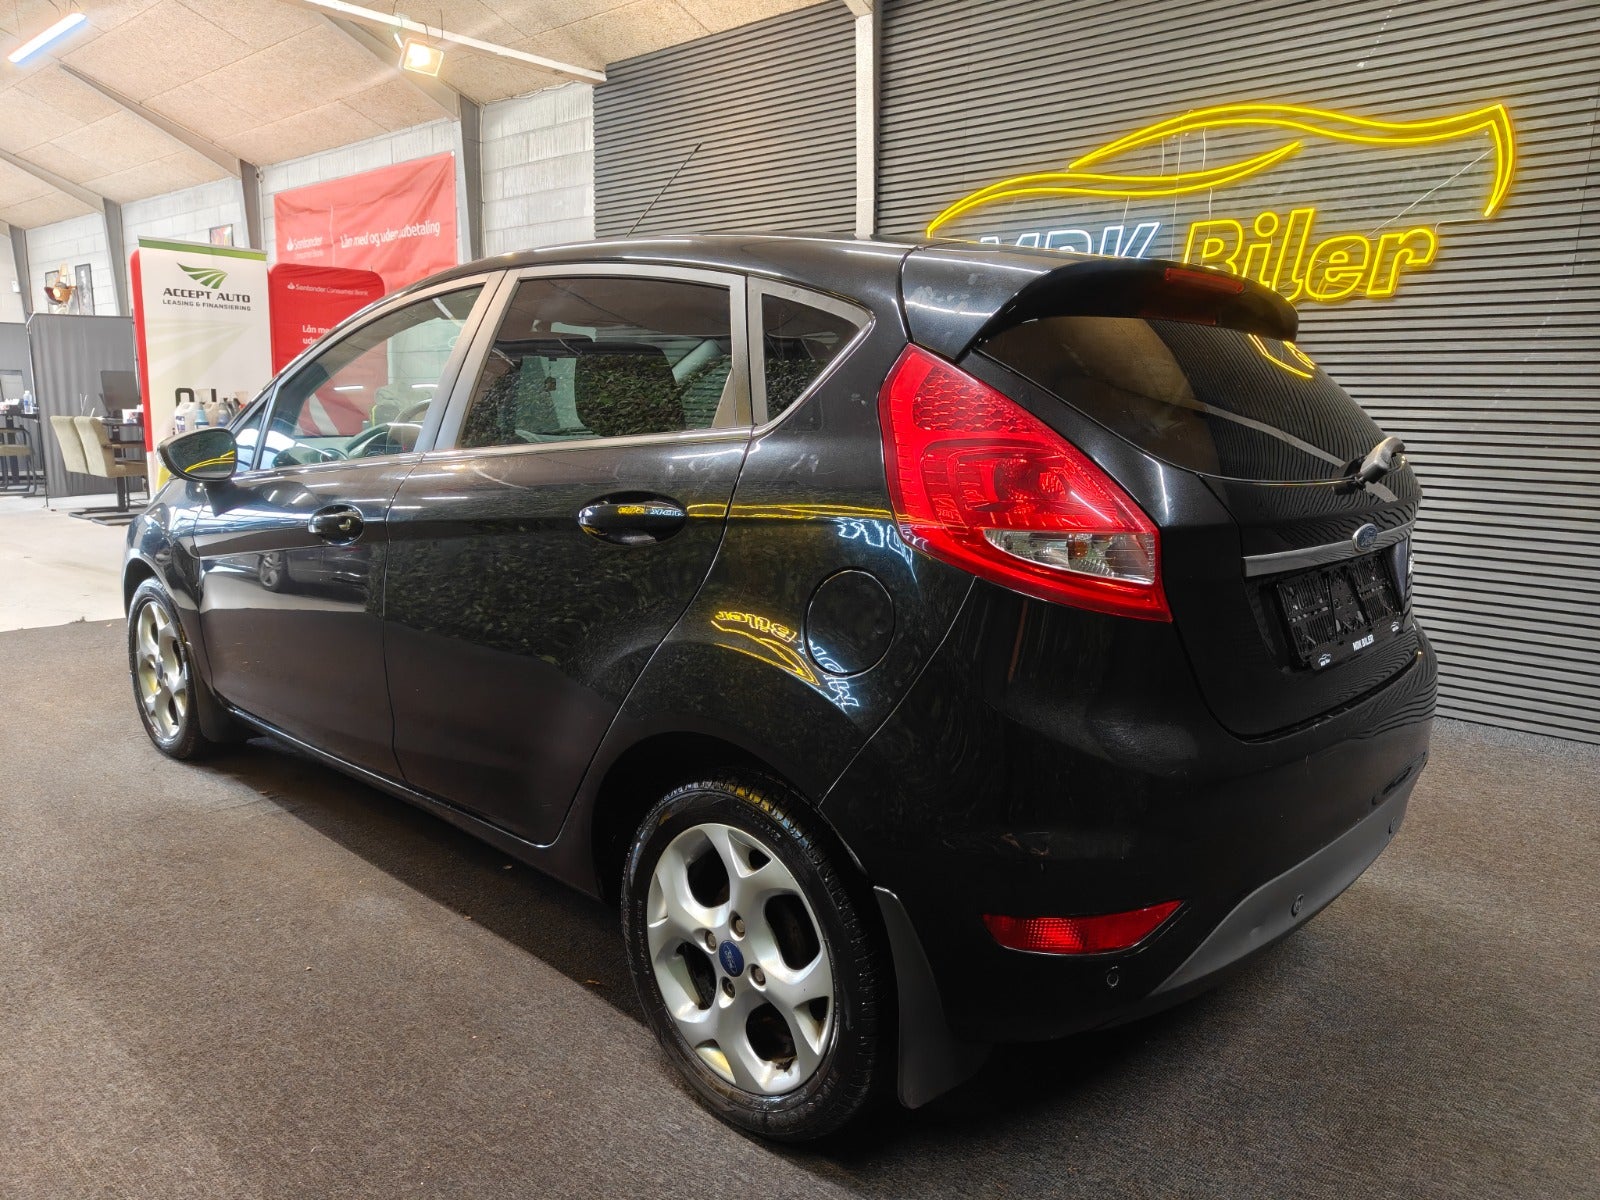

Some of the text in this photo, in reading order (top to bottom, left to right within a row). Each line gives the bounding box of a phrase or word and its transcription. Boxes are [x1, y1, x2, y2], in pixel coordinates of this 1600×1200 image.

[340, 233, 352, 249] Lån
[353, 232, 368, 246] med
[369, 233, 380, 247] og
[1183, 207, 1438, 302] Biler
[163, 287, 251, 303] ACCEPT AUTO
[295, 283, 326, 293] Santander
[162, 299, 194, 307] LEASING
[202, 301, 251, 311] FINANSIERING
[302, 324, 317, 333] Lån
